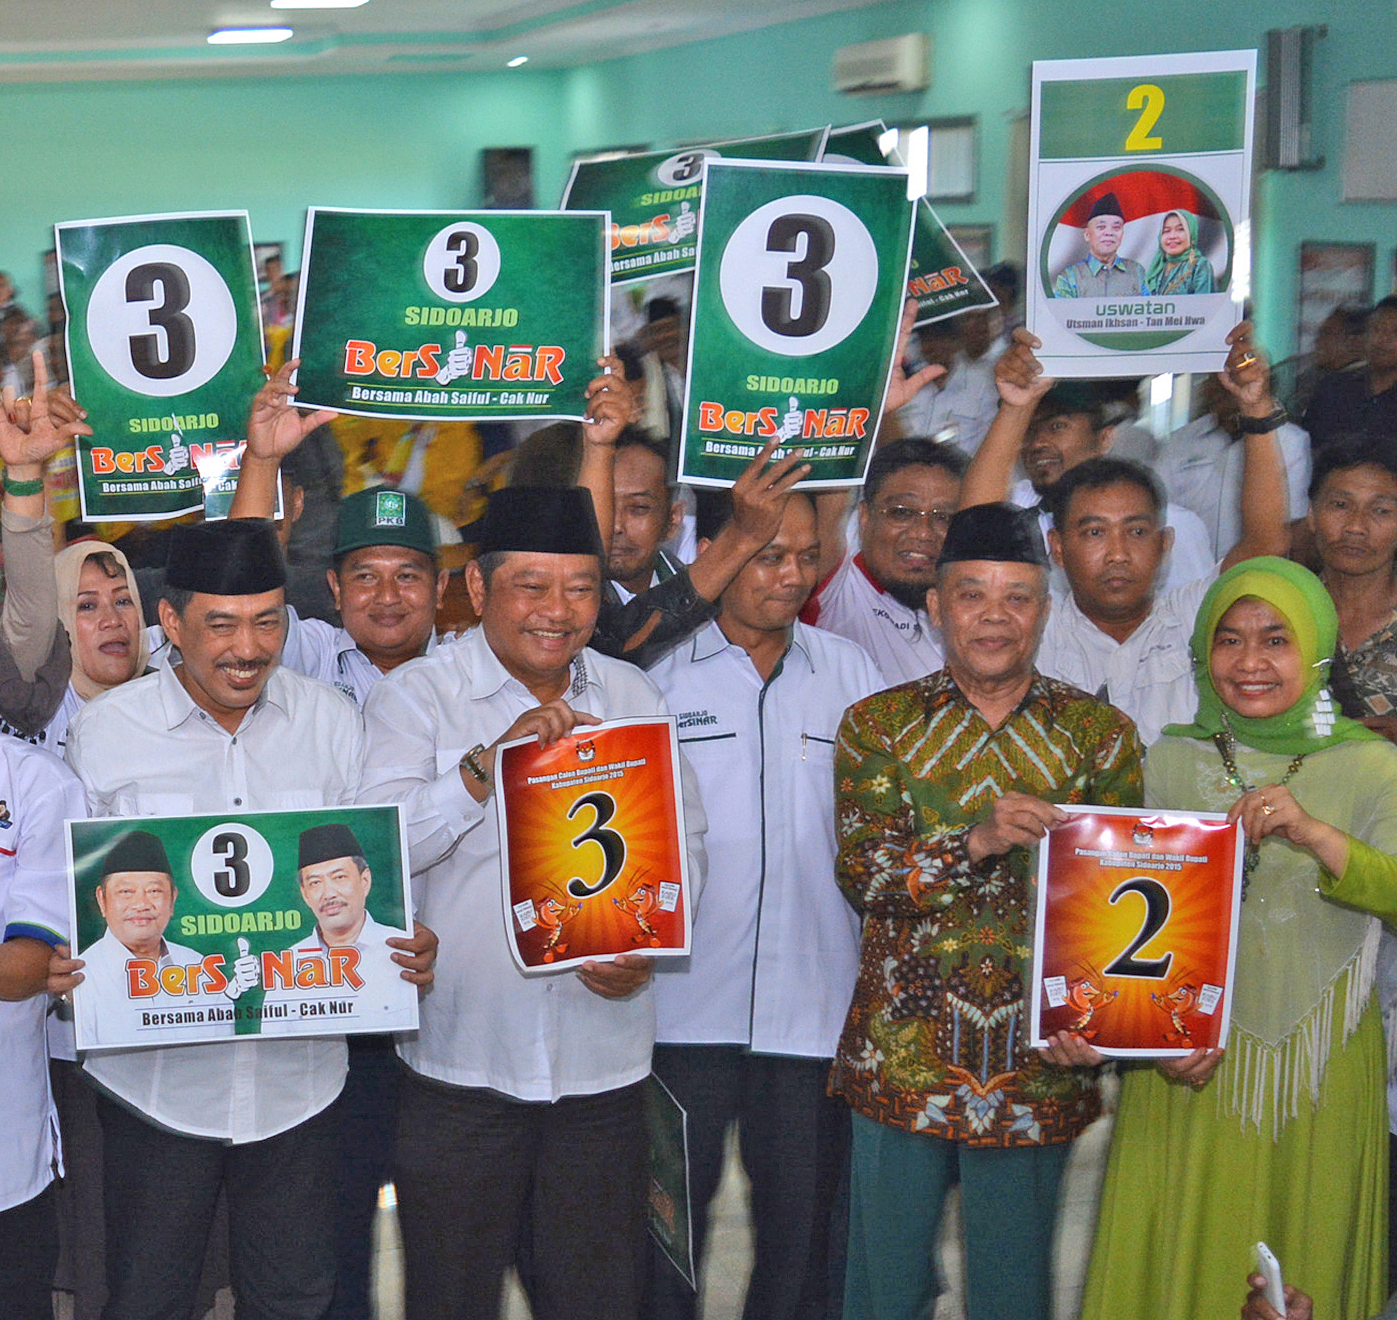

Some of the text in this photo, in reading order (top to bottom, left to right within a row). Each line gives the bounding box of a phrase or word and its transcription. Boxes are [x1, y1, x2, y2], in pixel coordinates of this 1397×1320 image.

[1125, 84, 1165, 150] 2
[672, 153, 705, 181] 3
[641, 186, 701, 206] SIDOA
[443, 231, 479, 293] 3
[654, 249, 680, 263] Abah
[761, 213, 835, 337] 3
[405, 306, 518, 327] SIDOARJO
[1096, 300, 1175, 317] uswatan
[125, 262, 197, 380] 3
[1066, 318, 1103, 329] Utsman
[1145, 317, 1162, 327] Tan
[1164, 316, 1182, 326] Mei
[747, 375, 839, 394] SIDOARJO
[352, 387, 414, 404] Bersama
[415, 390, 449, 405] Abah
[451, 391, 490, 405] Saiful
[499, 393, 525, 406] Cak
[525, 393, 549, 406] Nur
[129, 413, 219, 433] SIDOARJO
[706, 441, 755, 457] Bersama
[819, 447, 837, 457] Cak
[103, 481, 149, 493] Bersama
[151, 480, 177, 491] Abah
[379, 517, 404, 525] PKB
[677, 715, 718, 728] erSINAR
[528, 774, 557, 785] Pasangan
[609, 770, 624, 779] 2015
[566, 790, 627, 900] 3
[212, 832, 250, 897] 3
[1165, 862, 1182, 871] 2015
[180, 909, 301, 936] SIDOARJO
[1102, 876, 1174, 980] 2
[142, 1009, 204, 1026] Bersama
[207, 1007, 242, 1023] Abah
[245, 1003, 288, 1019] Saiful
[300, 1002, 326, 1017] Cak
[329, 1001, 354, 1016] Nur
